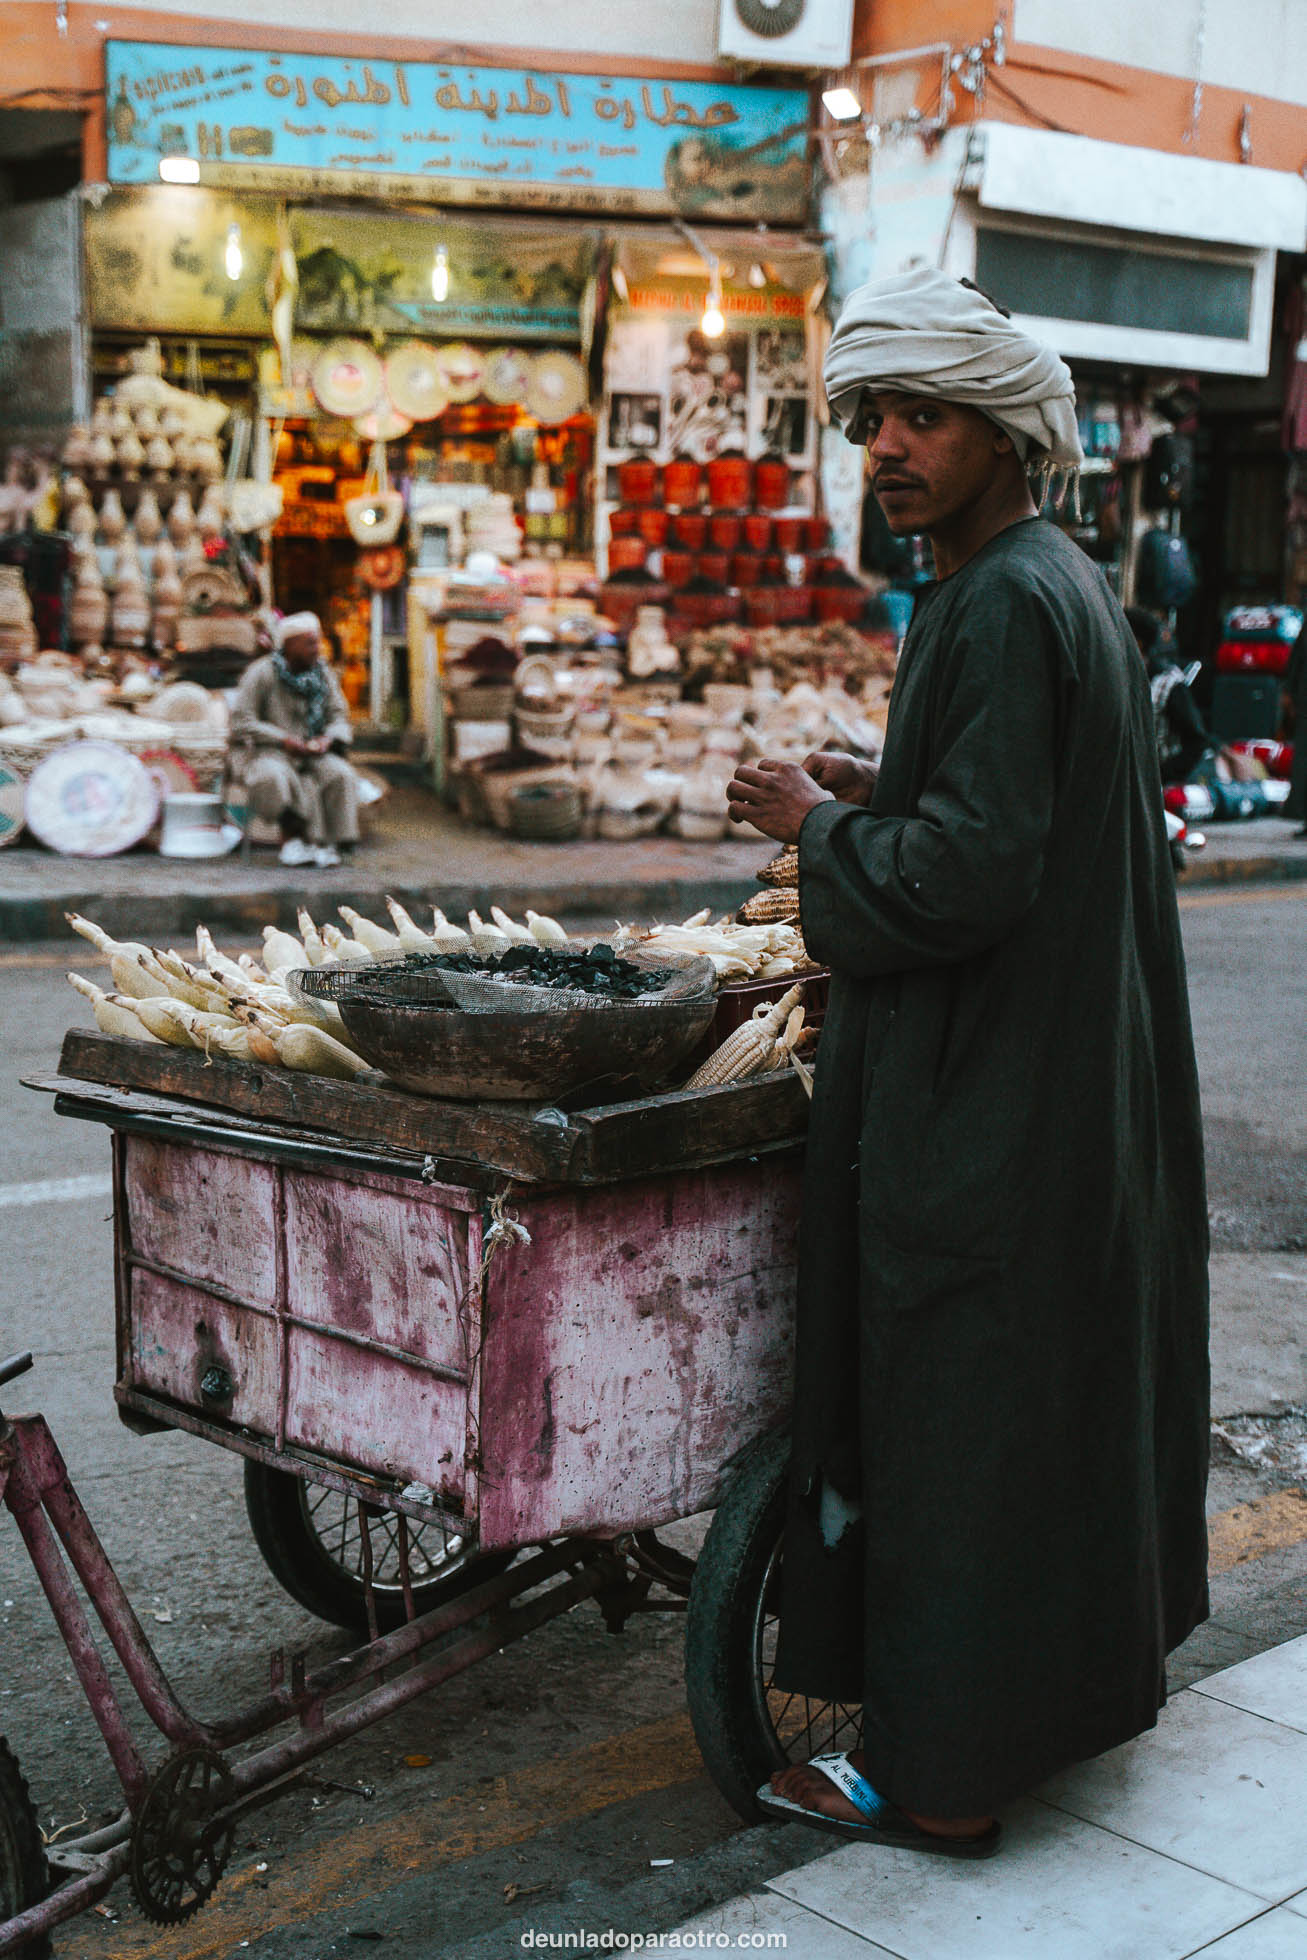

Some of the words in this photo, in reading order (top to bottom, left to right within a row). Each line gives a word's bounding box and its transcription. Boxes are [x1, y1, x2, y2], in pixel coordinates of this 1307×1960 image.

[264, 56, 410, 107] المنورة
[435, 70, 571, 120] المدينة
[595, 81, 740, 129] عطارة
[830, 1764, 841, 1774] AL
